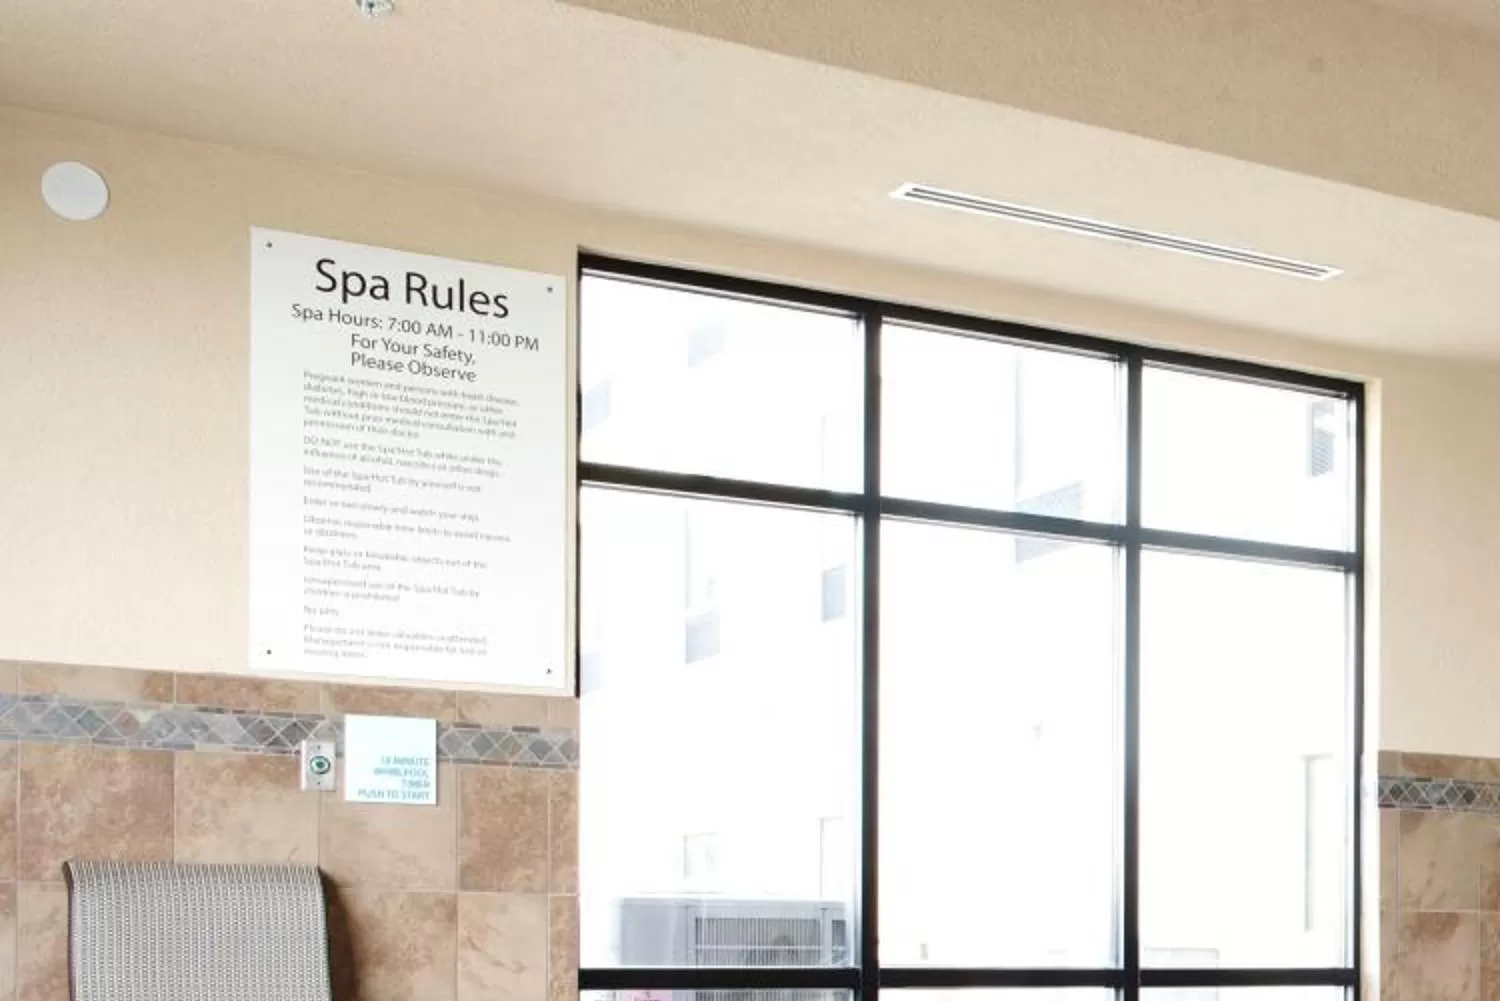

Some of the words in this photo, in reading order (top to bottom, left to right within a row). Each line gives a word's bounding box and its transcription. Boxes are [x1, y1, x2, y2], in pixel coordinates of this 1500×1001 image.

[315, 257, 389, 304] Spa
[404, 271, 509, 319] Rules
[291, 303, 323, 322] Spa
[328, 307, 383, 330] Hours:
[388, 317, 421, 334] 7:00
[426, 322, 453, 339] AM
[469, 329, 511, 347] 11:00
[515, 336, 540, 352] PM
[351, 333, 378, 350] For
[381, 337, 419, 355] Your
[422, 343, 476, 365] Safety,
[351, 352, 403, 373] Please
[408, 360, 477, 382] Observe
